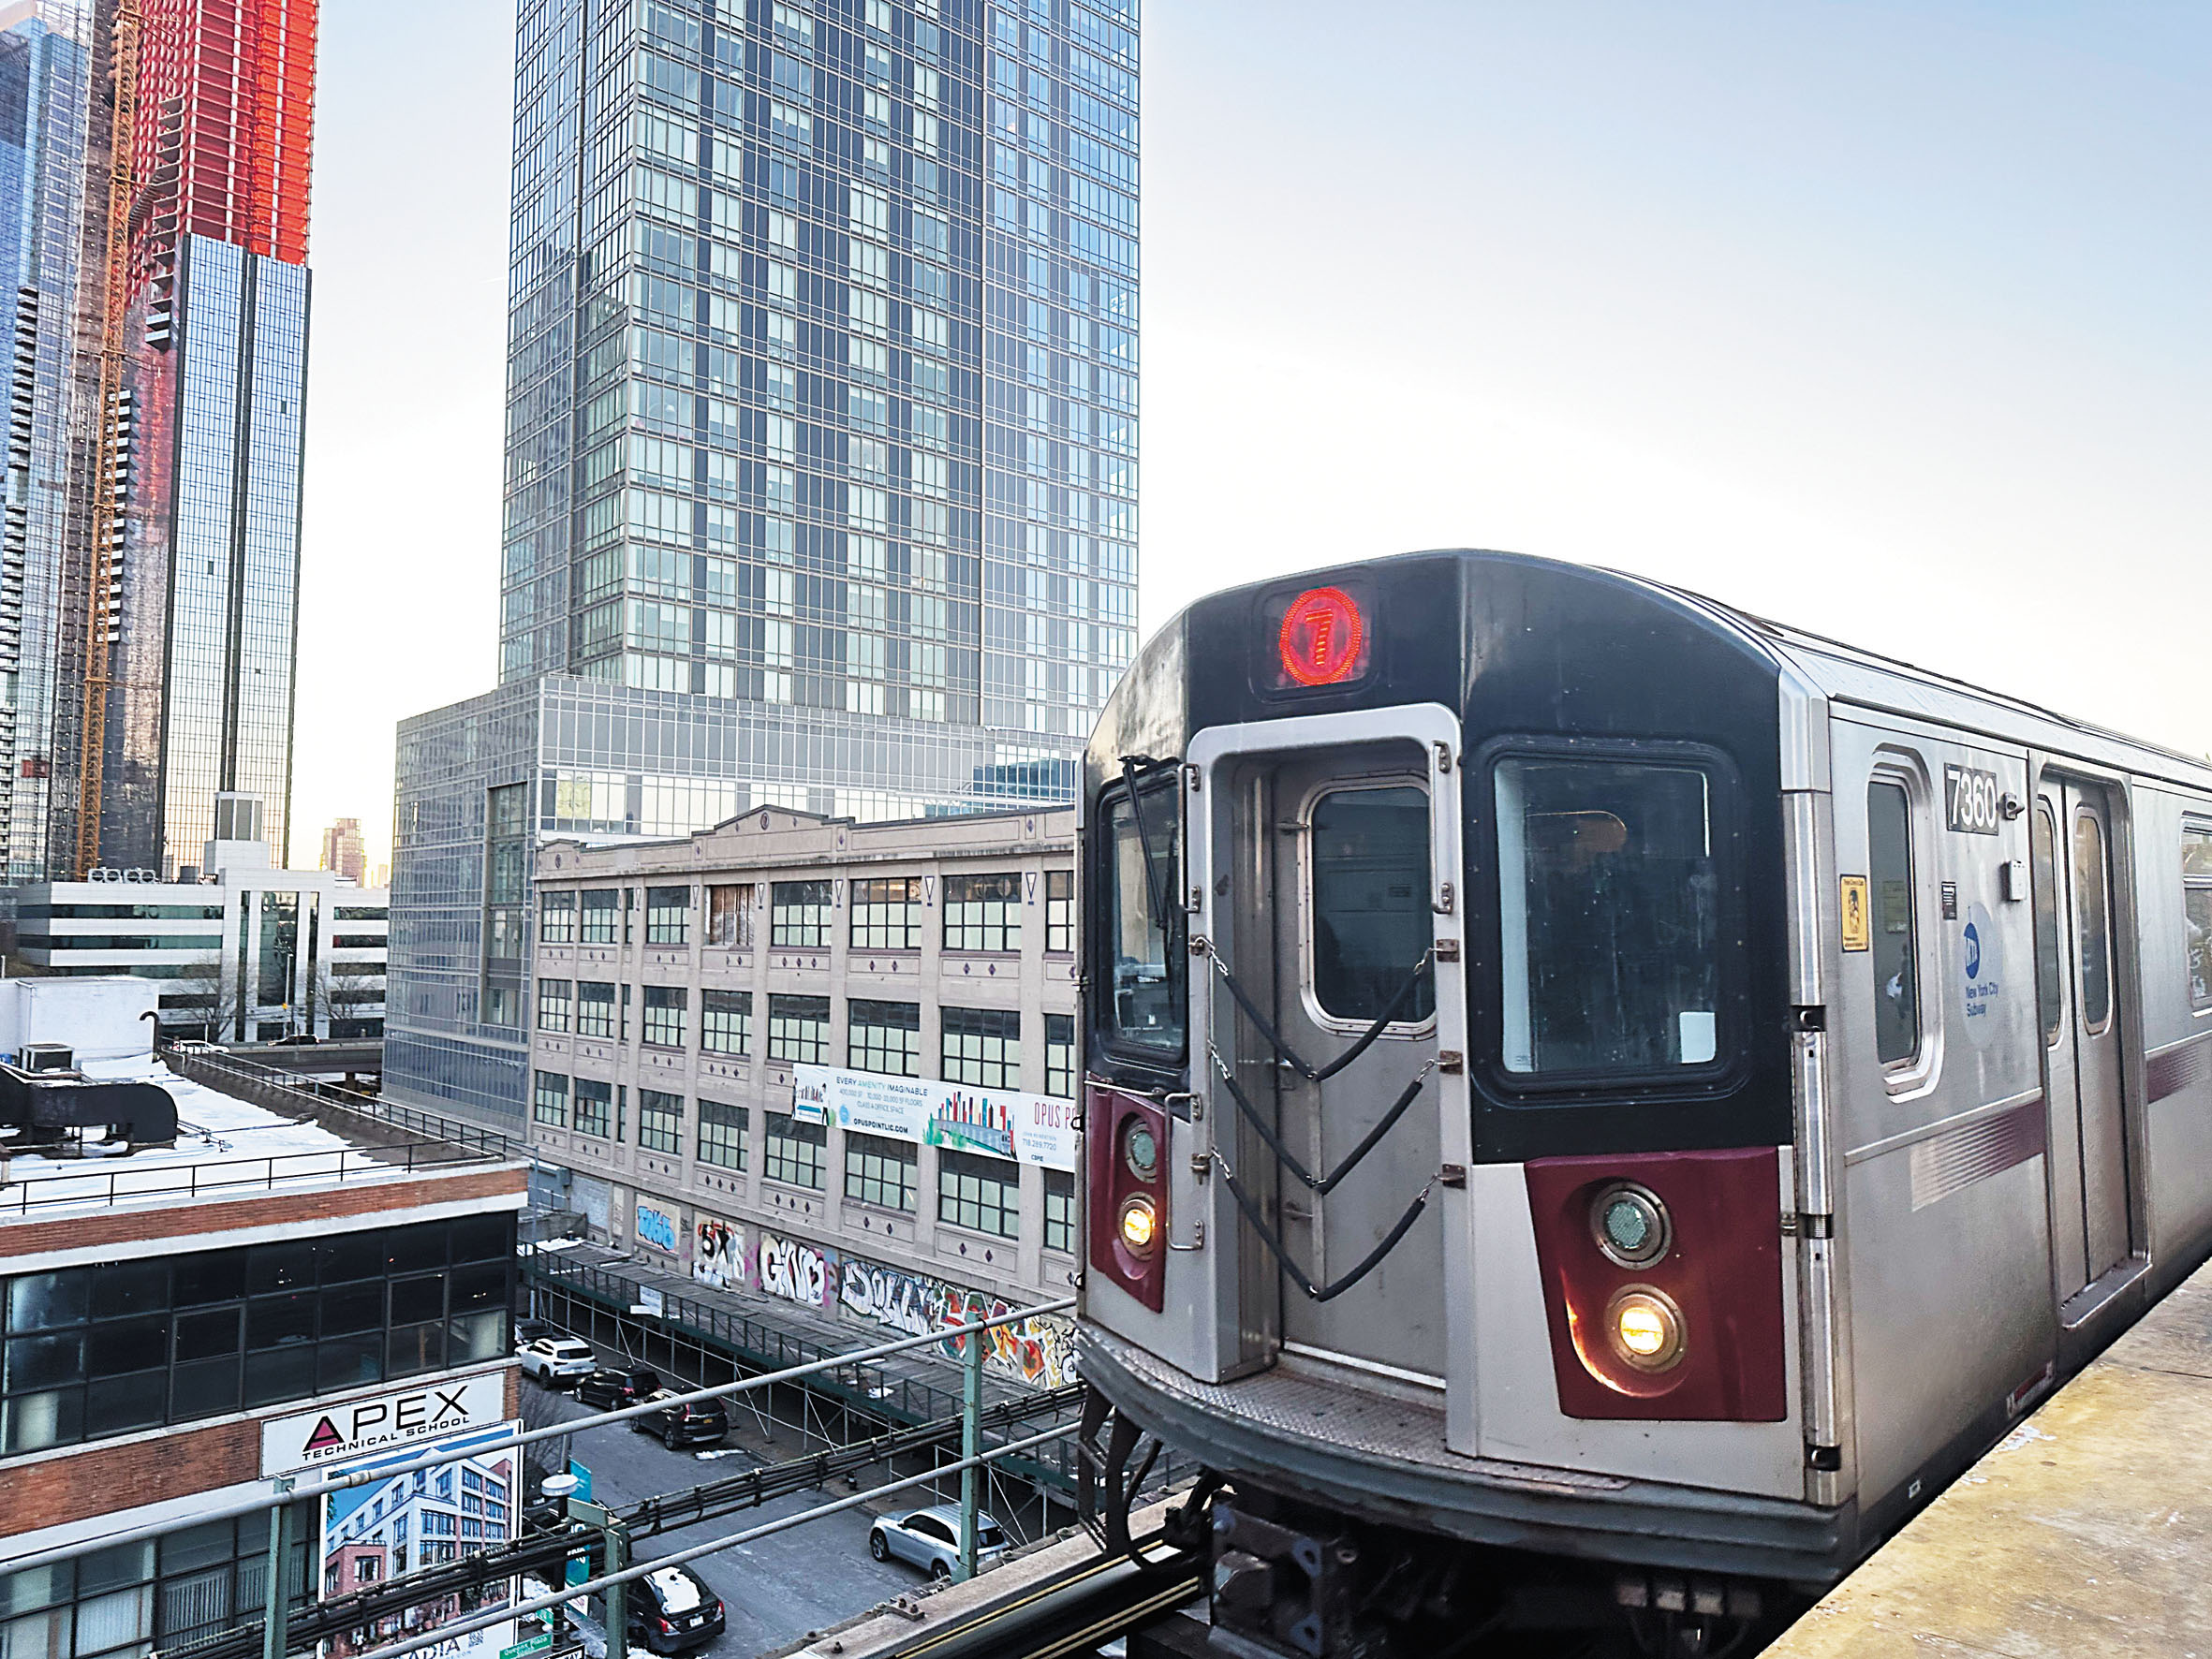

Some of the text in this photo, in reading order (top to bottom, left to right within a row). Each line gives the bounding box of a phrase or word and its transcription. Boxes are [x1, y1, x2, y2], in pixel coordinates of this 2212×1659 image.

[1305, 609, 1334, 666] 7
[1948, 770, 1996, 829] 7360
[1966, 981, 1998, 999] New York City
[1967, 1003, 1986, 1017] Subway
[836, 1077, 928, 1096] EVERY AMENITY IMAGINABLE
[853, 1118, 908, 1133] OPUSPOINTLIC.COM
[1035, 1102, 1060, 1128] OPUS
[302, 1386, 469, 1452] APEX
[302, 1416, 470, 1461] TECHNICAL SCHOOL
